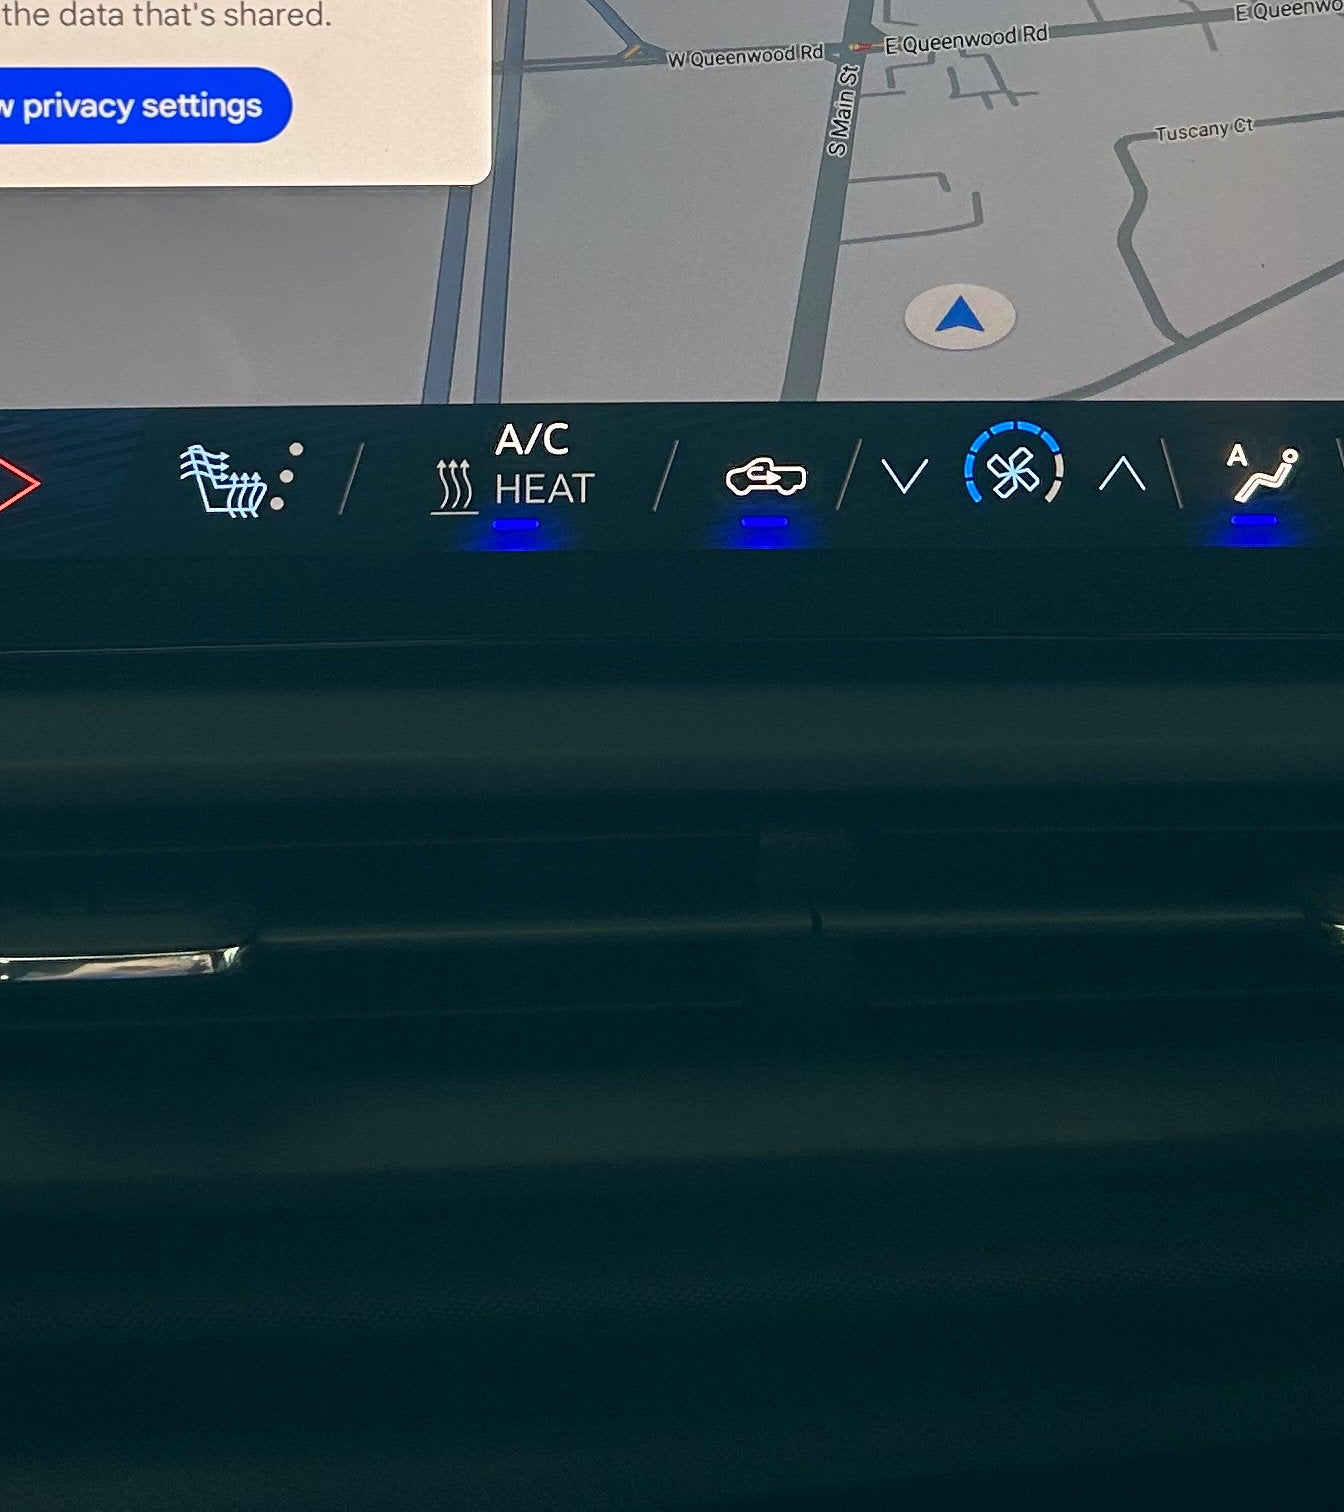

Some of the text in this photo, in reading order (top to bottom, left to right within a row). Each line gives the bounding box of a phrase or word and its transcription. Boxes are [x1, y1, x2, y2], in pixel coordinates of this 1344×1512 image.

[2, 1, 51, 28] the
[60, 1, 125, 28] data
[133, 1, 217, 28] that's
[224, 1, 333, 28] shared.
[1236, 4, 1247, 21] E
[886, 24, 1048, 54] E Queenwood Rd
[667, 44, 824, 68] W Queenwood Rd
[23, 91, 135, 126] privacy
[141, 91, 264, 126] settings
[828, 65, 859, 157] S Main St
[1155, 117, 1254, 141] Tuscany Ct
[494, 422, 571, 458] A/C
[1226, 443, 1249, 469] A
[495, 472, 597, 506] HEAT
